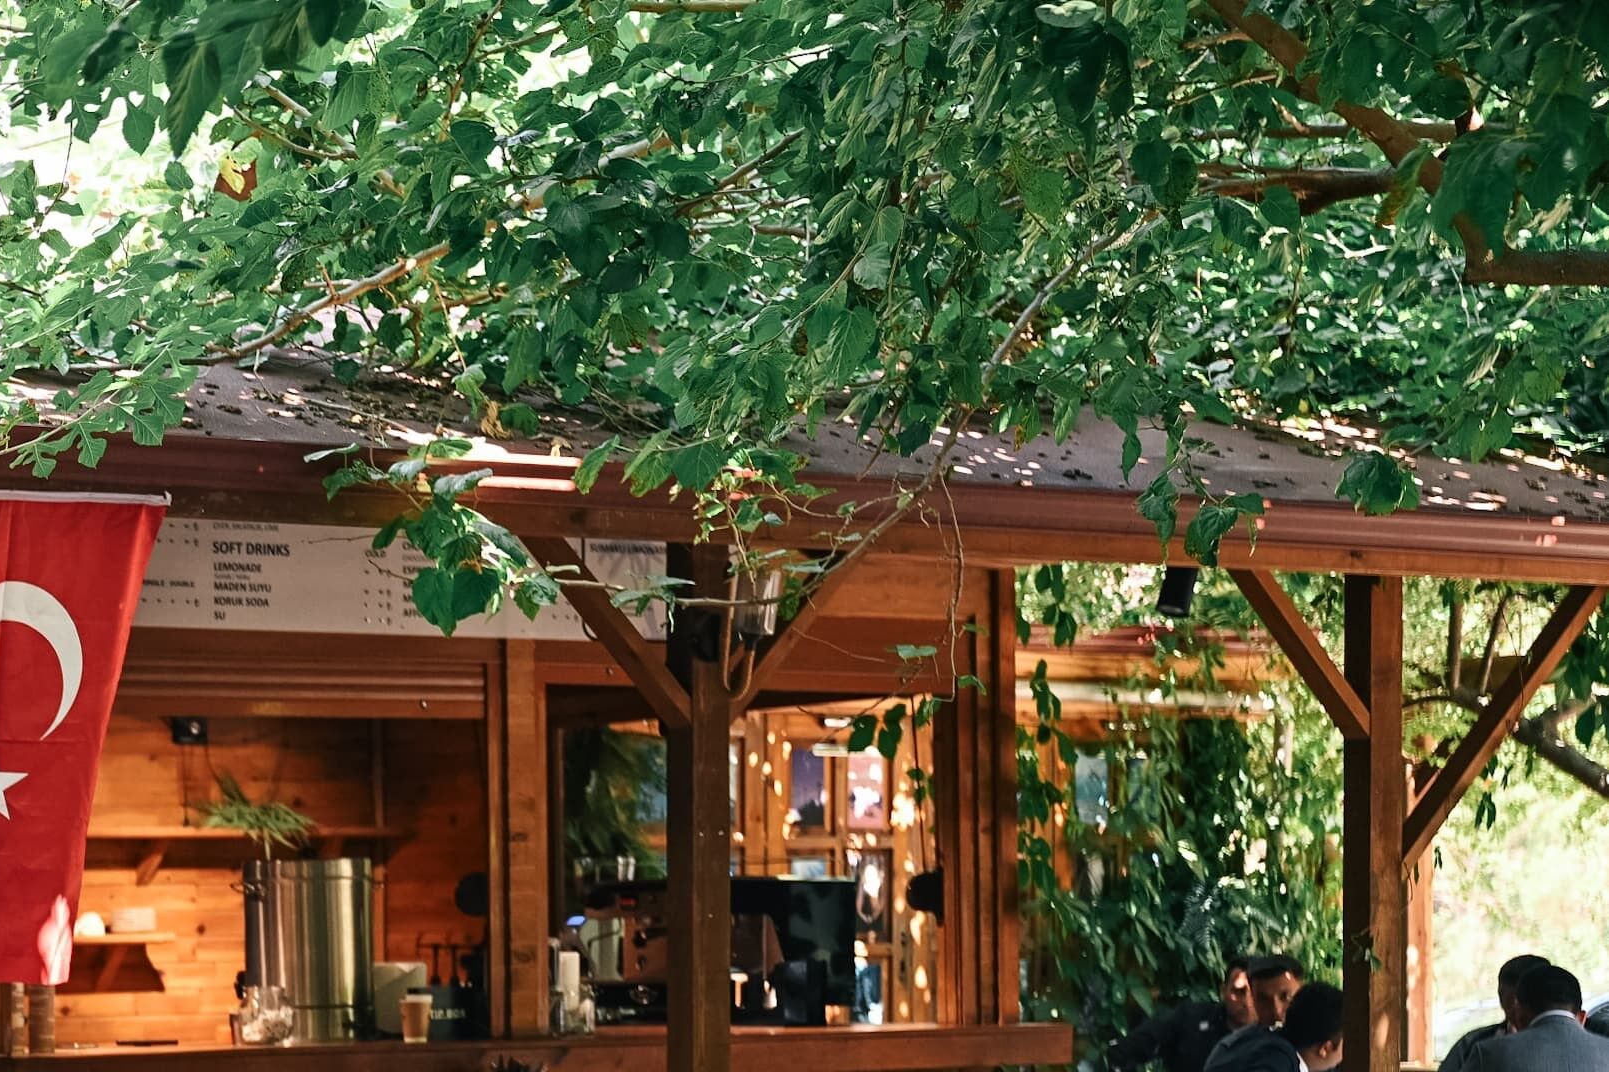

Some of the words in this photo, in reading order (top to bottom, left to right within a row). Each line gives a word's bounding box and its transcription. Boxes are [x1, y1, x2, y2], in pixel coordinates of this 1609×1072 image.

[212, 541, 242, 555] SOFT
[246, 542, 290, 557] DRINKS
[213, 562, 262, 573] LEMONADE
[213, 581, 246, 592] MADEN
[245, 598, 270, 608] SODA
